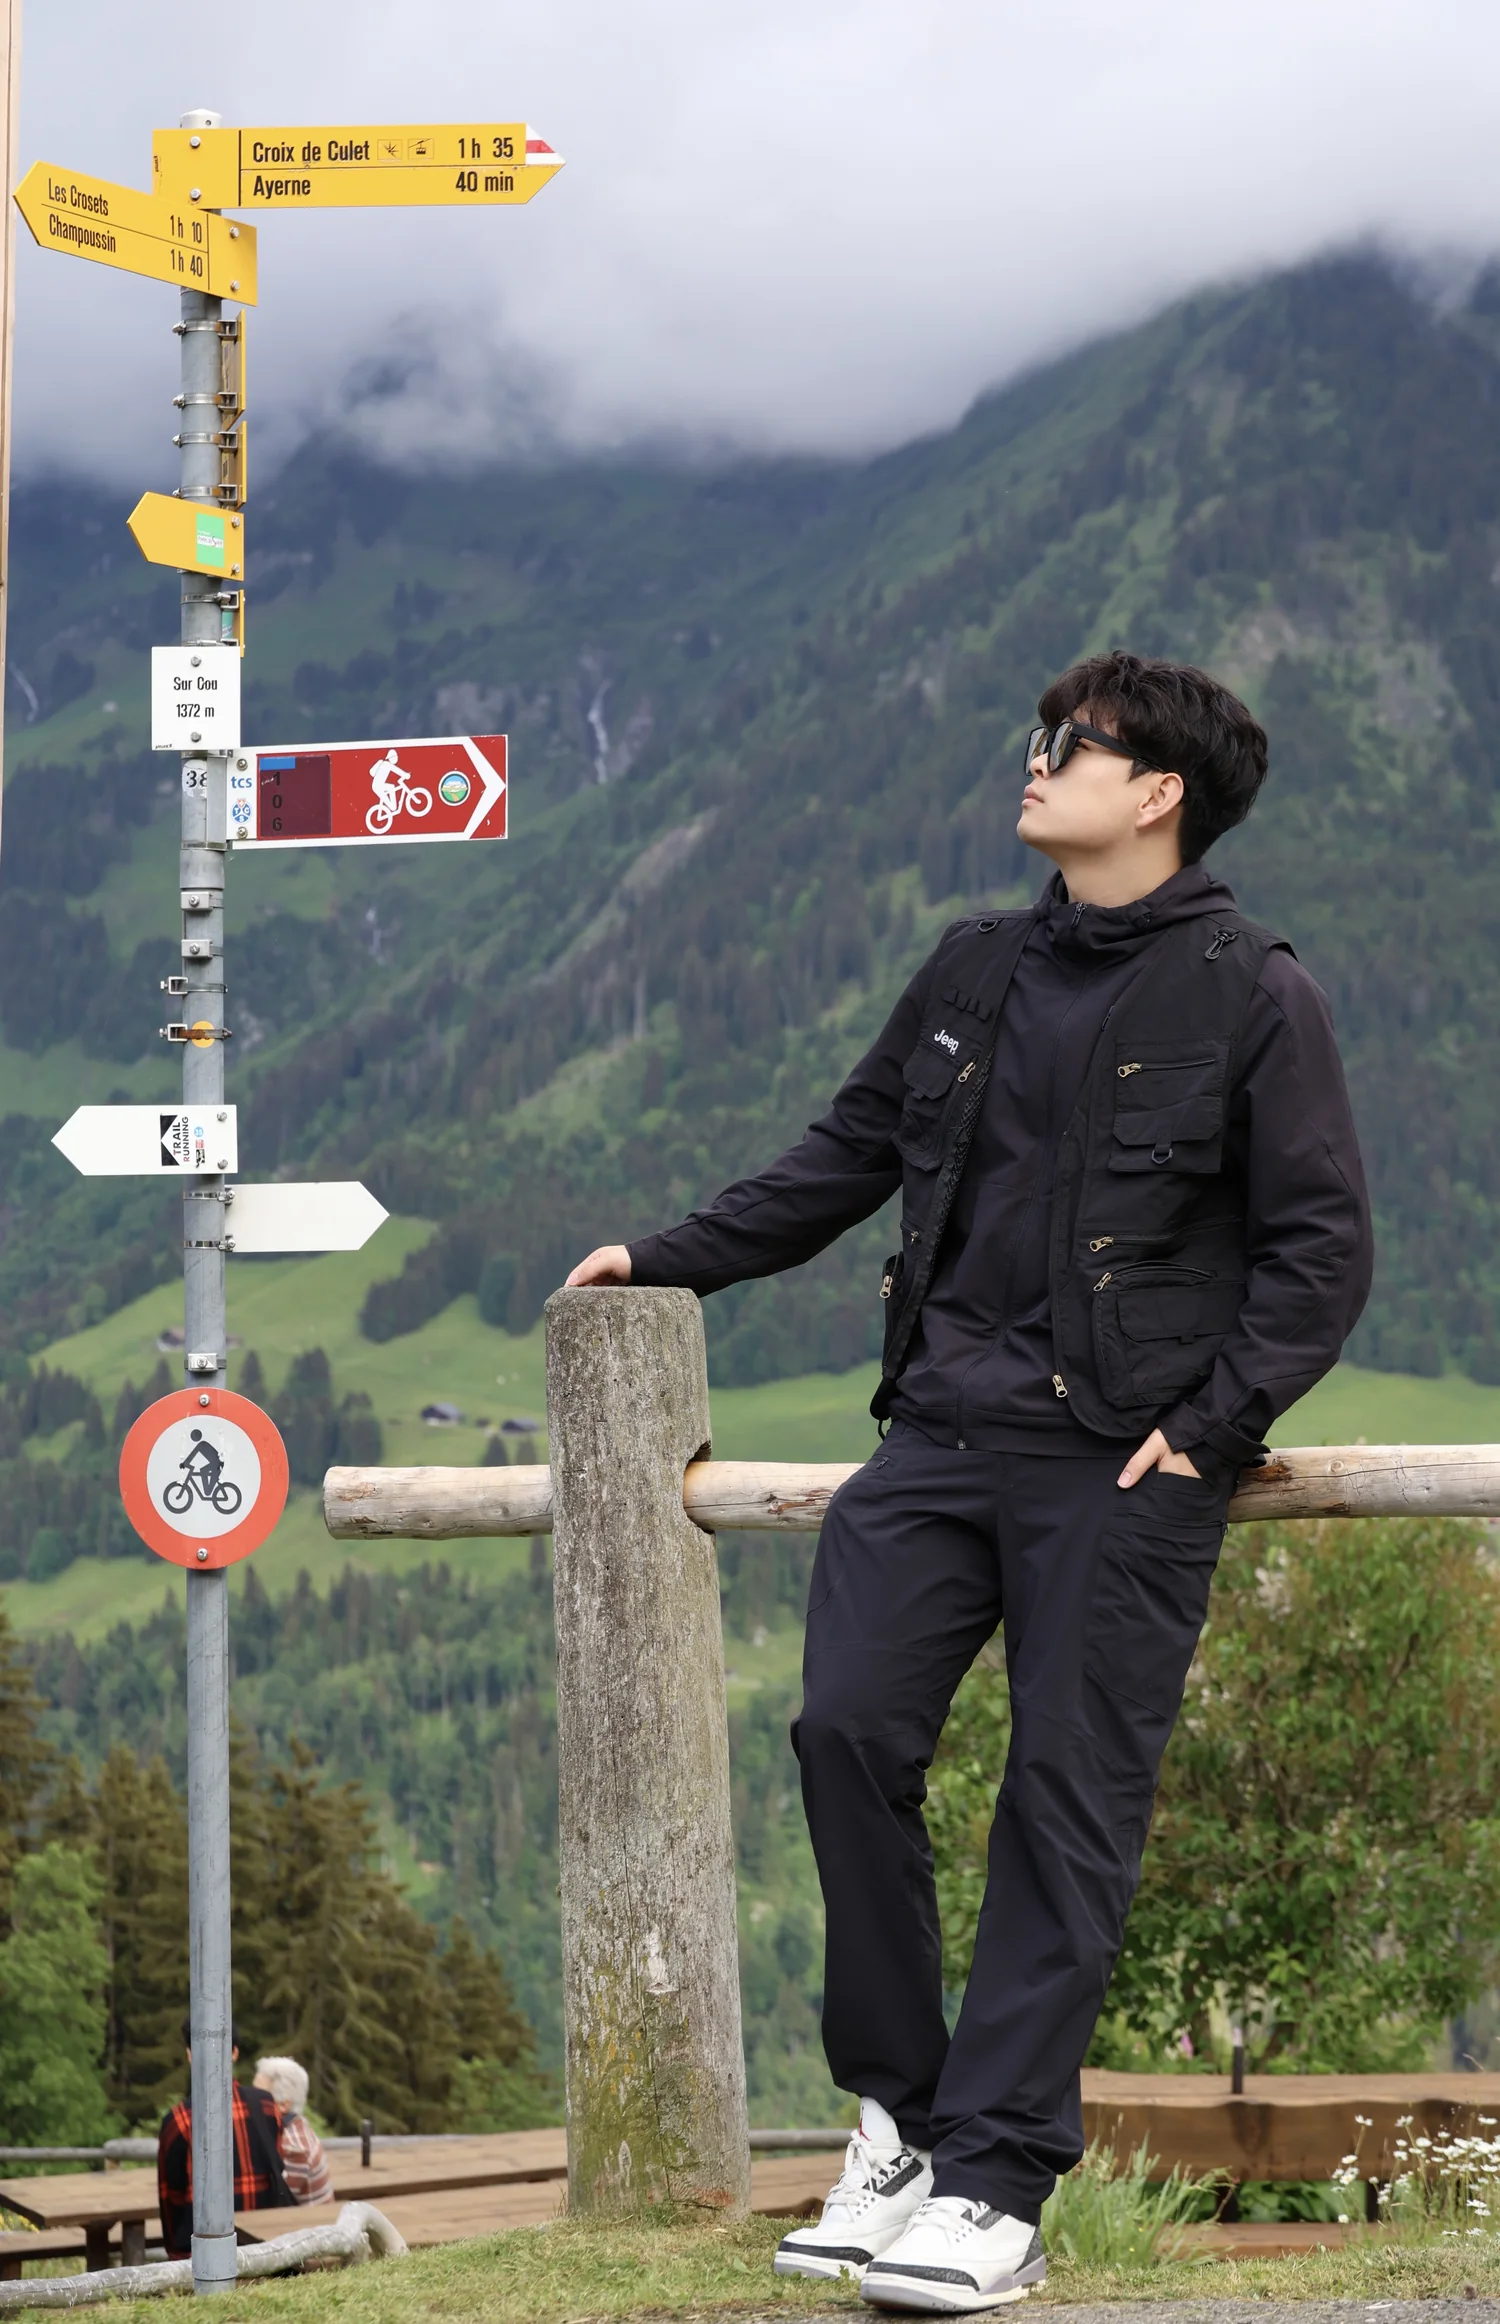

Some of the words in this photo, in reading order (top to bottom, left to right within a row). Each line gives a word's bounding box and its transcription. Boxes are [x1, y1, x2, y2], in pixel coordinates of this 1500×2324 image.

[252, 141, 295, 163] Croix
[301, 141, 322, 162] de
[327, 140, 370, 161] Culet
[458, 137, 465, 158] 1
[471, 137, 481, 158] h
[492, 137, 514, 158] 35
[252, 175, 311, 200] Ayerne
[455, 171, 478, 192] 40
[484, 171, 514, 192] min
[48, 177, 67, 204] Les
[70, 184, 109, 216] Crosets
[170, 214, 175, 236] 1
[177, 216, 184, 239] h
[191, 221, 202, 244] 10
[49, 213, 116, 253] Champoussin
[170, 248, 175, 270] 1
[178, 250, 185, 273] h
[189, 254, 203, 278] 40
[173, 676, 192, 691] Sur
[197, 676, 218, 691] Cou
[175, 703, 201, 718] 1372
[204, 706, 215, 718] m
[230, 775, 253, 789] tcs
[934, 1029, 959, 1054] Jeep
[172, 1122, 182, 1156] TRAIL
[181, 1116, 190, 1163] RUNNING
